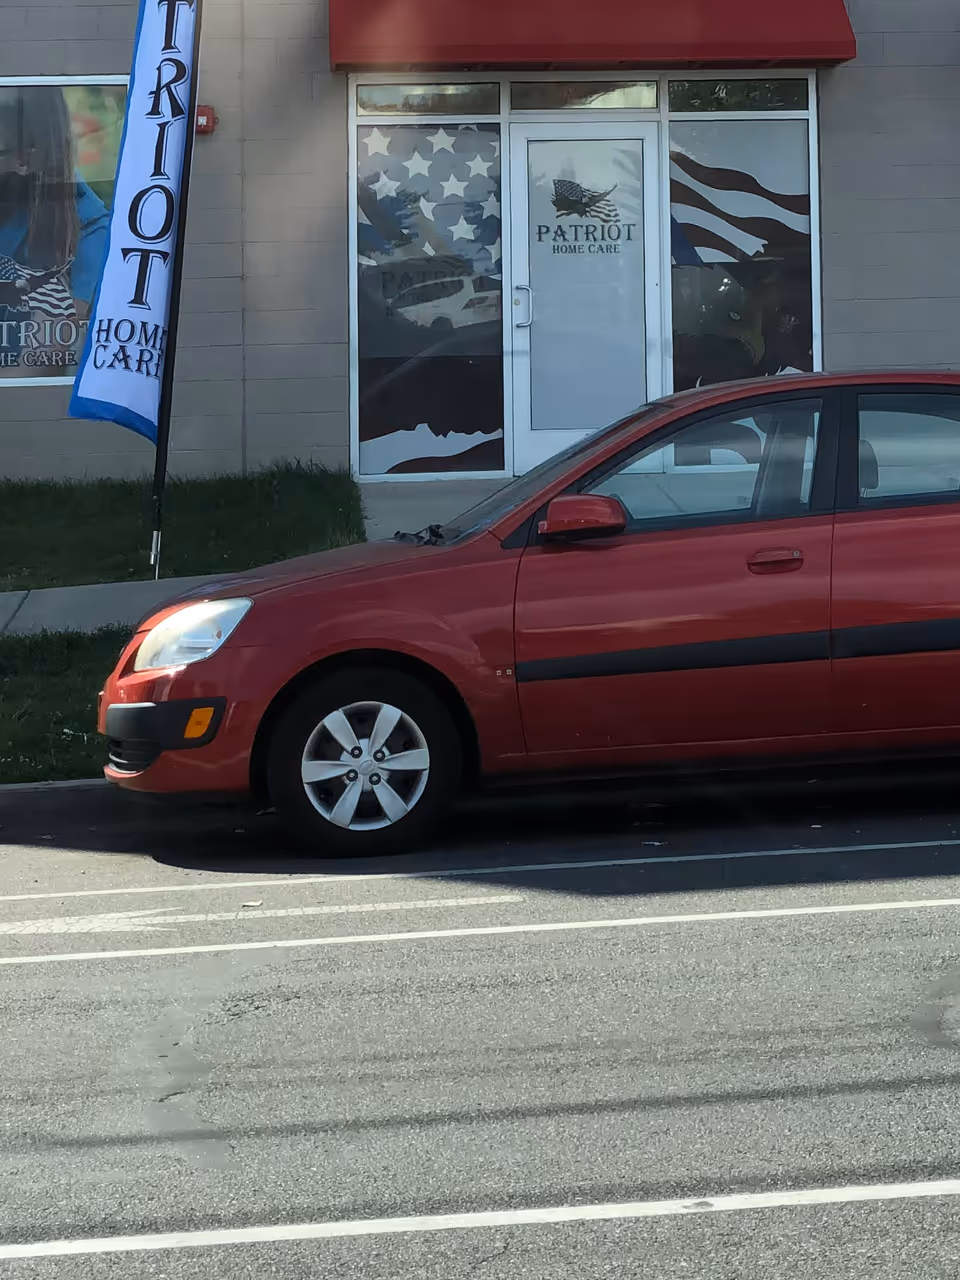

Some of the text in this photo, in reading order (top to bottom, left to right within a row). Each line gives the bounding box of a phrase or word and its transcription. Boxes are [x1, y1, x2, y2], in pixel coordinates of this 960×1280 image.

[536, 223, 637, 242] PATRIOT
[552, 244, 620, 254] HOME CARE
[23, 350, 78, 368] CARE
